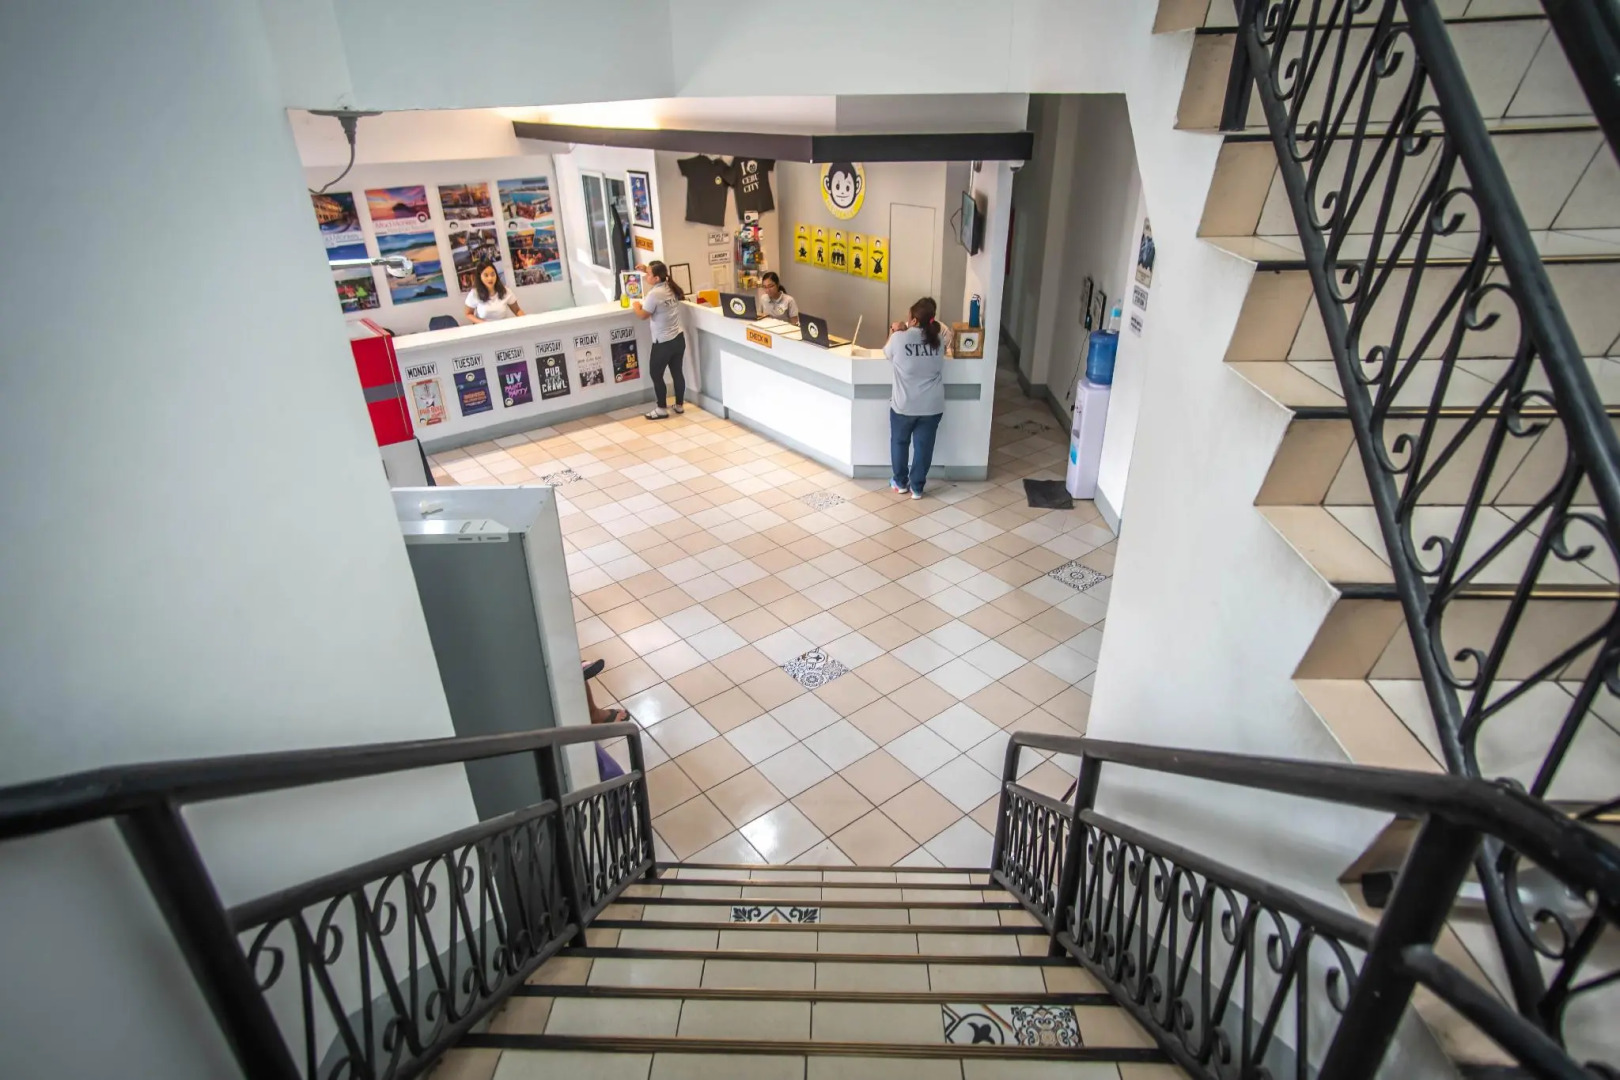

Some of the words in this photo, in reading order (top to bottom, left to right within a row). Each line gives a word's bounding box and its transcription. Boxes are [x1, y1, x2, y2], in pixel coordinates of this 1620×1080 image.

[743, 182, 760, 193] CITY
[611, 328, 633, 340] SATURDAY
[749, 331, 764, 341] CHECK
[575, 335, 598, 347] FRIDAY
[536, 342, 561, 353] THURSDAY
[497, 349, 522, 362] WEDNESDAY
[454, 356, 481, 369] TUESDAY
[407, 364, 436, 379] MONDAY
[505, 371, 522, 385] UV
[541, 379, 568, 393] CRAWL
